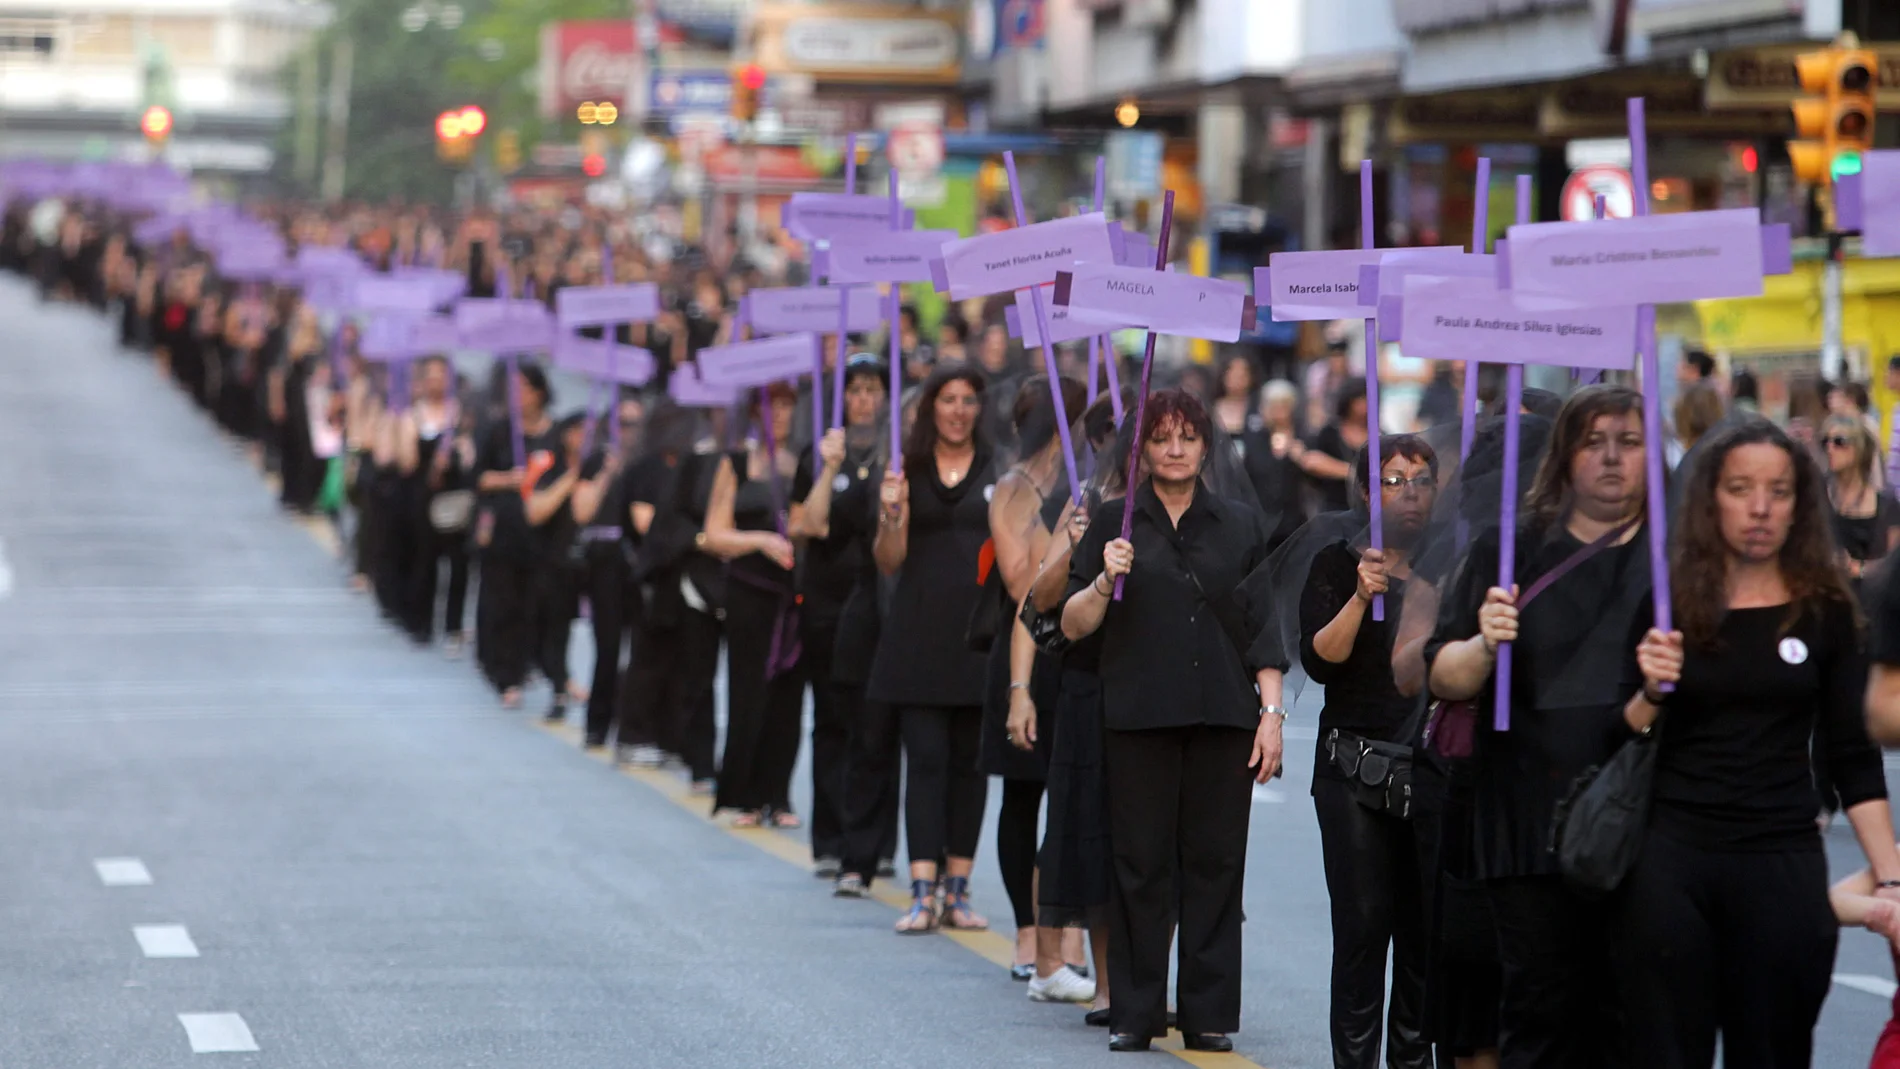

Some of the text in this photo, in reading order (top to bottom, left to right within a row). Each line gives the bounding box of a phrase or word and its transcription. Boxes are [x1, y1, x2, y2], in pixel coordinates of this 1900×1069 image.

[985, 259, 1011, 271] Yanet
[1013, 253, 1042, 266] Florita
[1106, 280, 1154, 296] MAGELA
[1289, 283, 1332, 294] Marcela
[1434, 315, 1603, 336] Paula Andrea Silva Iglesias
